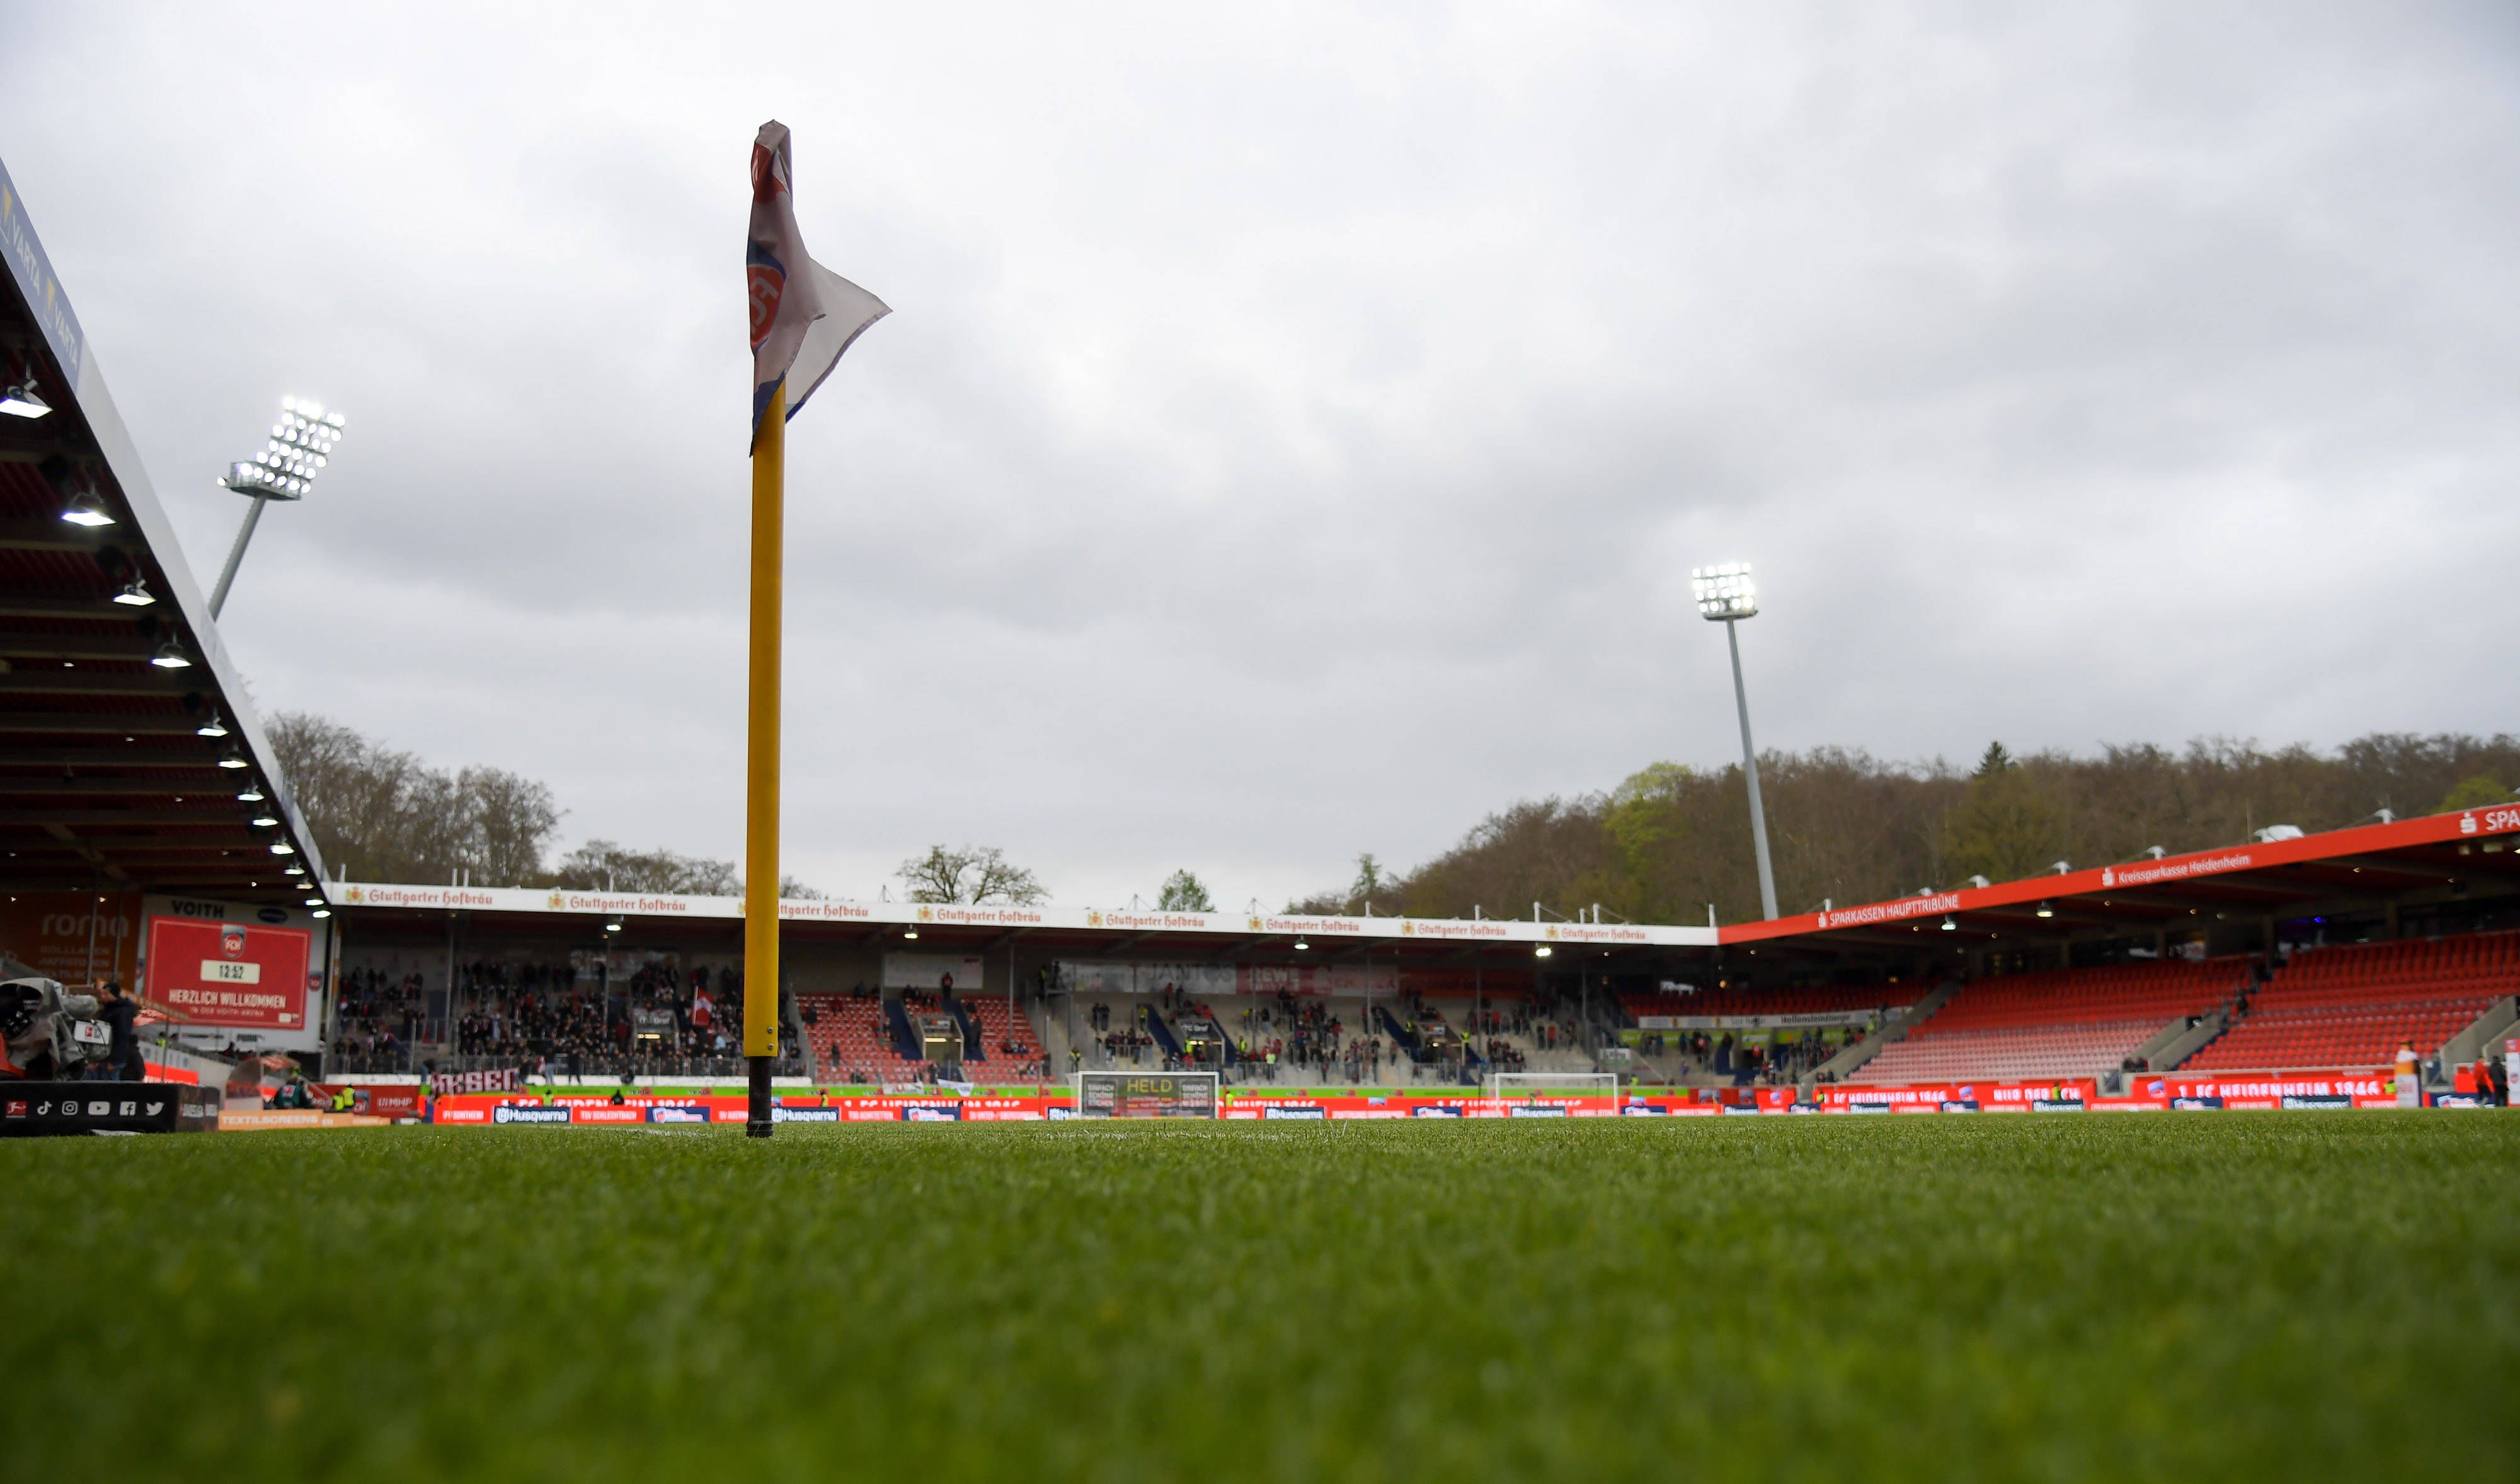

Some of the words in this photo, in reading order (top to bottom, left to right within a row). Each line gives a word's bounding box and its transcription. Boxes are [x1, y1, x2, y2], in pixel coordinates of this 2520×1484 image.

[13, 213, 40, 297] VARTA
[55, 301, 77, 371] VARTA
[2485, 808, 2520, 831] SPA
[2118, 866, 2187, 883] Kreissparkasse
[2189, 854, 2250, 873] Heidenheim
[370, 889, 440, 906] Stuttgarter
[443, 891, 493, 906] Hofbräu
[571, 896, 634, 912] Stuttgarter
[639, 898, 685, 912] Hofbräu
[172, 900, 224, 919] VOITH
[779, 905, 820, 919] ttgarter
[824, 904, 868, 919] Hofbräu
[937, 909, 995, 924] Stuttgarter
[999, 910, 1041, 924] Hofbräu
[1830, 905, 1885, 927] SPARKASSEN
[1886, 894, 1959, 917] HAUPTTRIBÜNE
[1106, 914, 1162, 929] Stuttgarter
[1165, 916, 1205, 929] Hofbräu
[1266, 919, 1319, 933] Stuttgarter
[1322, 920, 1360, 933] Hofbräu
[1418, 924, 1467, 938] Stuttgarter
[1470, 924, 1506, 938] Hofbräu
[1561, 928, 1608, 941] Stuttgarter
[1612, 929, 1645, 941] Hofbräu
[169, 989, 218, 1005] HERZLICH
[220, 992, 286, 1009] WILLKOMMEN
[1127, 1078, 1172, 1093] HELD
[2219, 1082, 2330, 1098] HEIDENHEIM
[2334, 1081, 2380, 1095] 1846
[1848, 1091, 1917, 1104] HEIDENHEIM
[222, 1115, 319, 1125] TEXTILSCREENS
[510, 1108, 568, 1122] Husqvarna
[783, 1110, 837, 1122] Husqvarna
